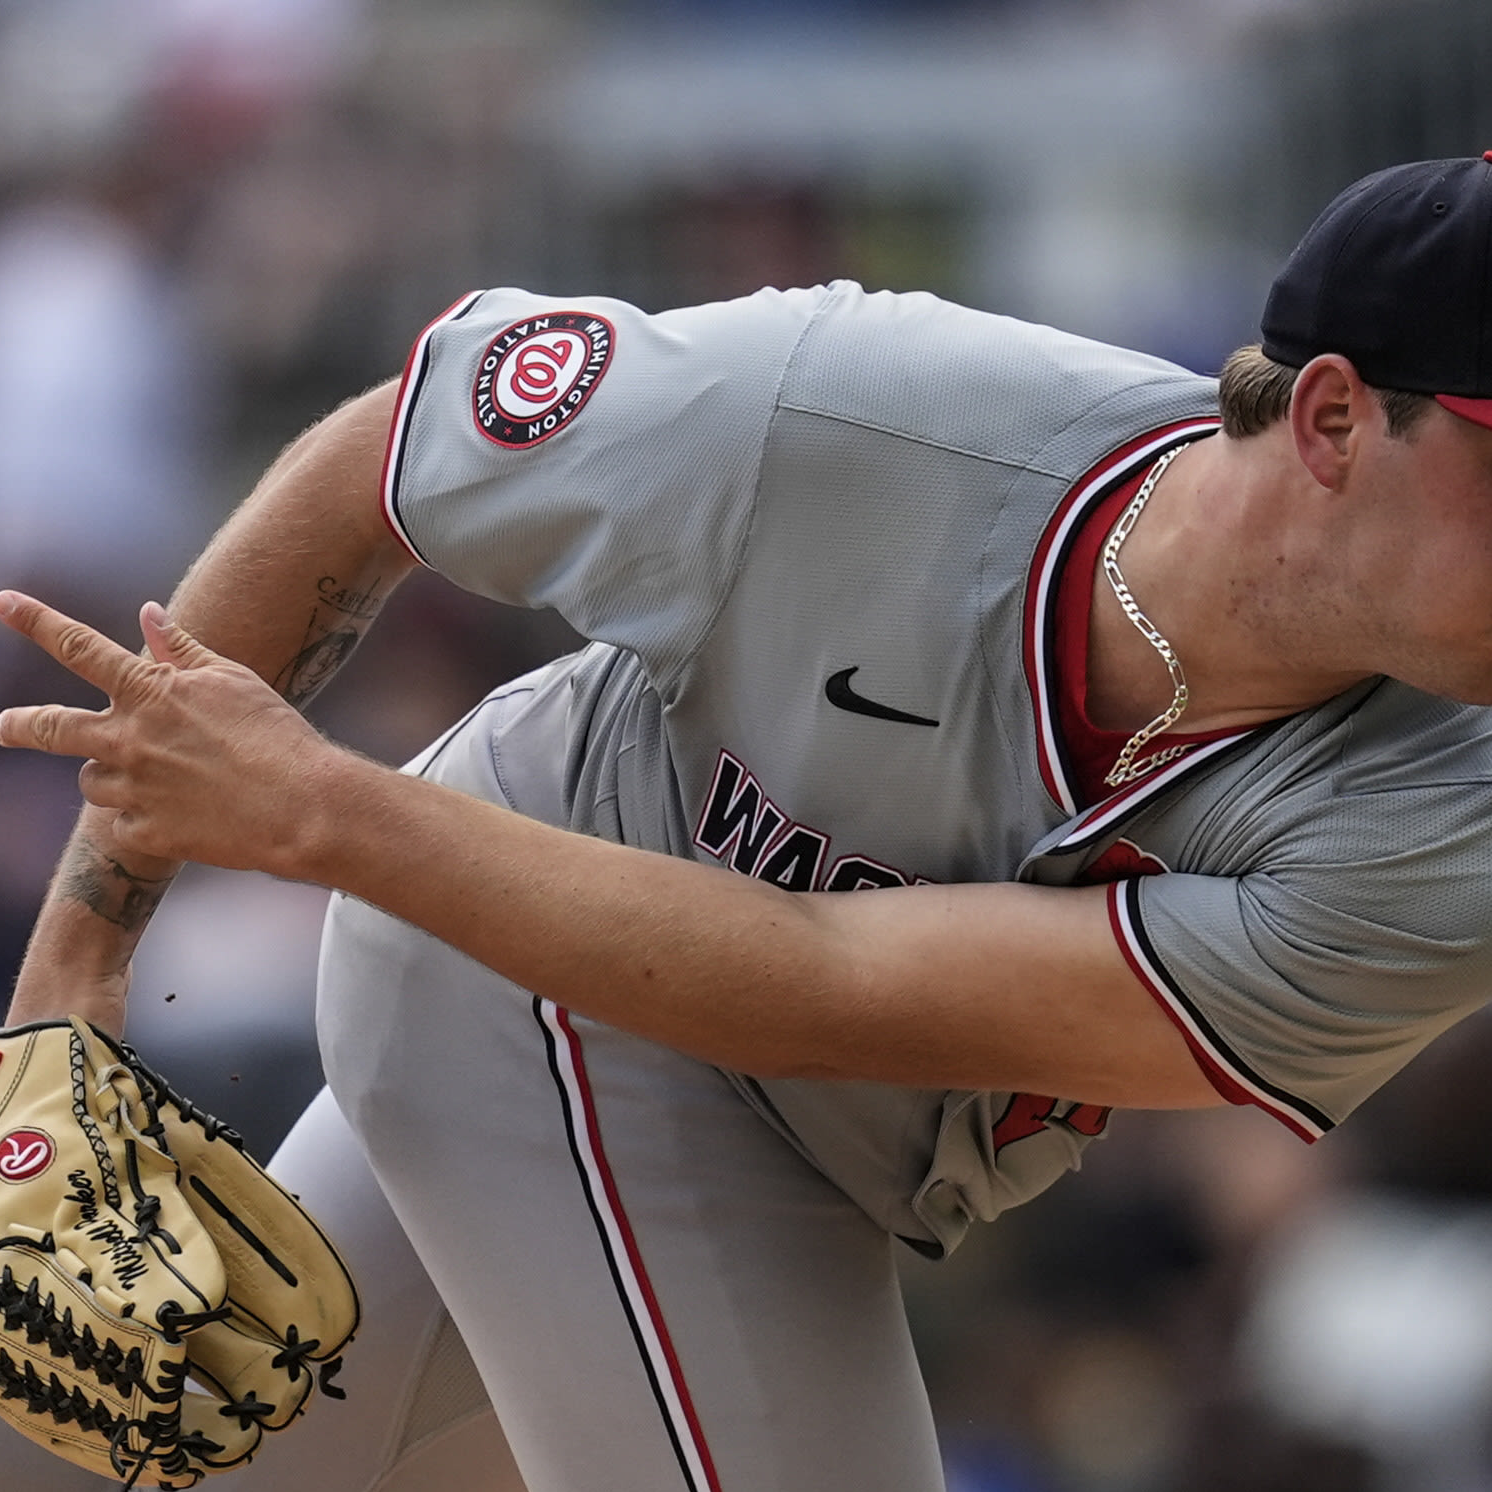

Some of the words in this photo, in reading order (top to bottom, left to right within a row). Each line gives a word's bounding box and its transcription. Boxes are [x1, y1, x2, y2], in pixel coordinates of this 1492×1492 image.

[476, 318, 551, 428] NATIONALS
[510, 340, 573, 404] W
[528, 320, 608, 439] WASHINGTON
[0, 1137, 48, 1176] R
[63, 1169, 100, 1230] Parker
